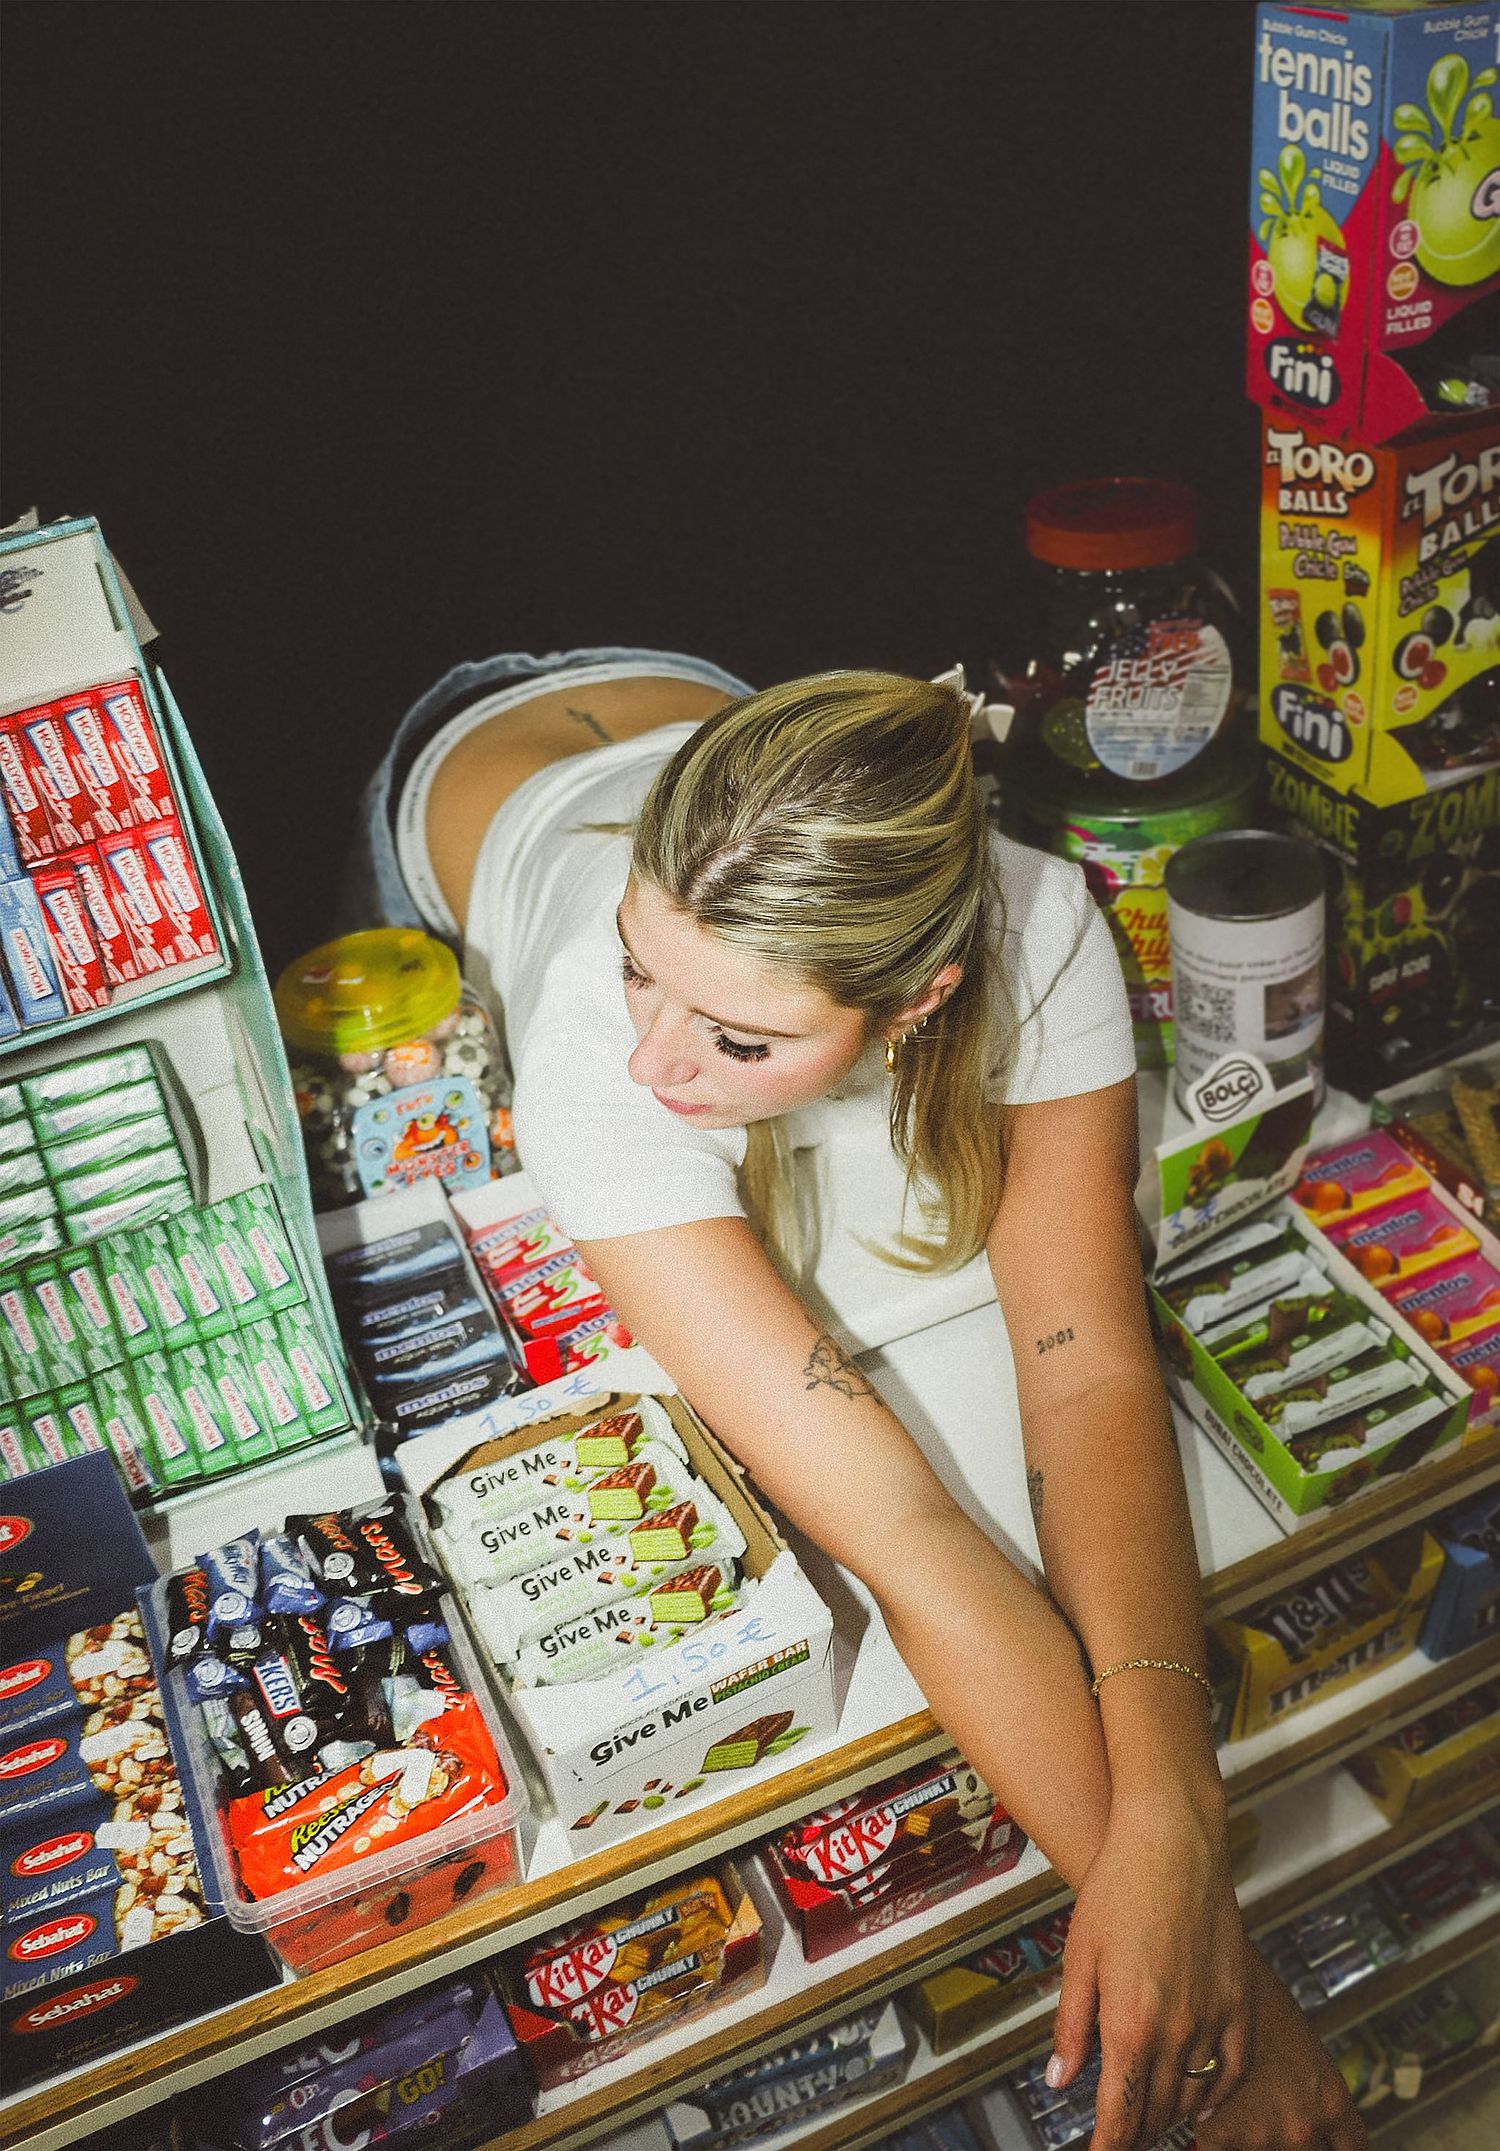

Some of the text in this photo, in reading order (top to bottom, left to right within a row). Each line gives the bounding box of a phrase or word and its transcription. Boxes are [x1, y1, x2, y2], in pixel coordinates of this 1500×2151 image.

[1258, 33, 1373, 107] tennis
[1278, 90, 1370, 161] balls
[1322, 174, 1359, 196] FILLED
[1323, 159, 1360, 180] LIQUID
[1385, 316, 1432, 335] FILLED
[1386, 300, 1432, 320] LIQUID
[1270, 345, 1333, 404] Fini
[1267, 428, 1375, 492] TORO
[1278, 488, 1349, 515] BALLS
[1106, 660, 1179, 683] JELLY
[1092, 687, 1183, 711] FRUITS
[1277, 688, 1346, 761] Fini
[1267, 761, 1361, 853] ZOMBIE
[1304, 1148, 1377, 1184] mentos
[475, 1209, 550, 1252] mento
[1349, 1208, 1423, 1248] mentos
[498, 1248, 580, 1301] mento
[1399, 1271, 1473, 1313] mentos
[361, 1290, 445, 1327] mentos
[556, 1309, 617, 1344] ntos
[374, 1321, 465, 1363] mentos
[1036, 1327, 1076, 1355] 2001
[396, 1374, 491, 1417] mentos
[470, 1452, 557, 1499] Give Me
[480, 1505, 570, 1554] Give Me
[360, 1521, 424, 1595] Mars
[521, 1548, 611, 1601] Give Me
[540, 1609, 631, 1659] Give Me
[711, 1640, 808, 1694] WAFER BAR
[715, 1670, 771, 1704] PISTACHIO
[589, 1695, 709, 1767] Give Me
[813, 1777, 953, 1881] KitKat CHUNKY
[23, 1837, 84, 1871] Sebahat
[8, 1885, 48, 1912] Mixed
[51, 1873, 83, 1896] Nuts
[86, 1864, 111, 1883] Bar
[20, 1920, 86, 1955] Sebahat
[534, 1905, 677, 2007] KitKat CHUNKY
[3, 1970, 47, 1998] Mixed
[87, 1949, 113, 1968] Bar
[636, 1955, 697, 1993] CHUNKY
[28, 1982, 124, 2027] Sebahat
